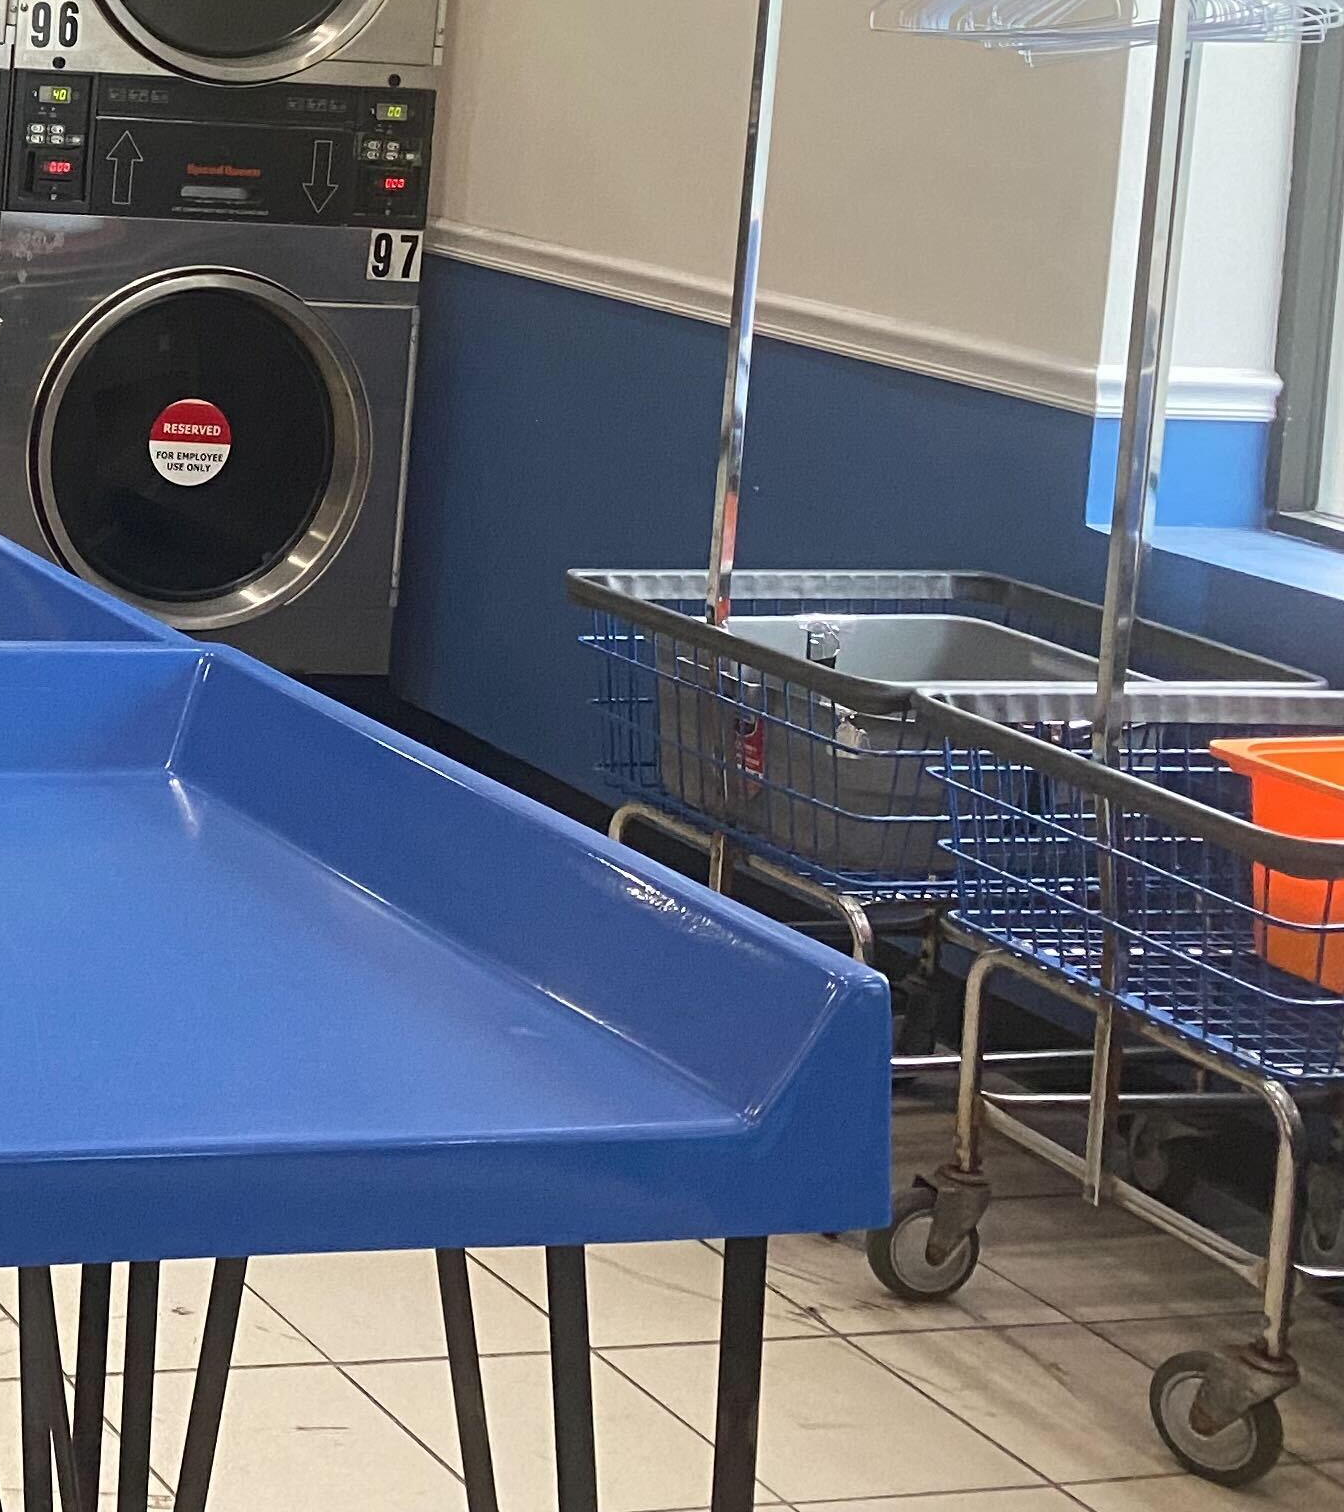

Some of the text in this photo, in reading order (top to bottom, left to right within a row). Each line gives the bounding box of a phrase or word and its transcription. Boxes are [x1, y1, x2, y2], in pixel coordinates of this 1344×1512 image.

[30, 1, 80, 48] 96
[52, 89, 67, 101] 40
[387, 106, 402, 118] 00
[371, 232, 420, 279] 97
[163, 423, 221, 436] RESERVED
[156, 451, 223, 462] FOR EMPLOYEE
[166, 462, 211, 472] USE ONLY
